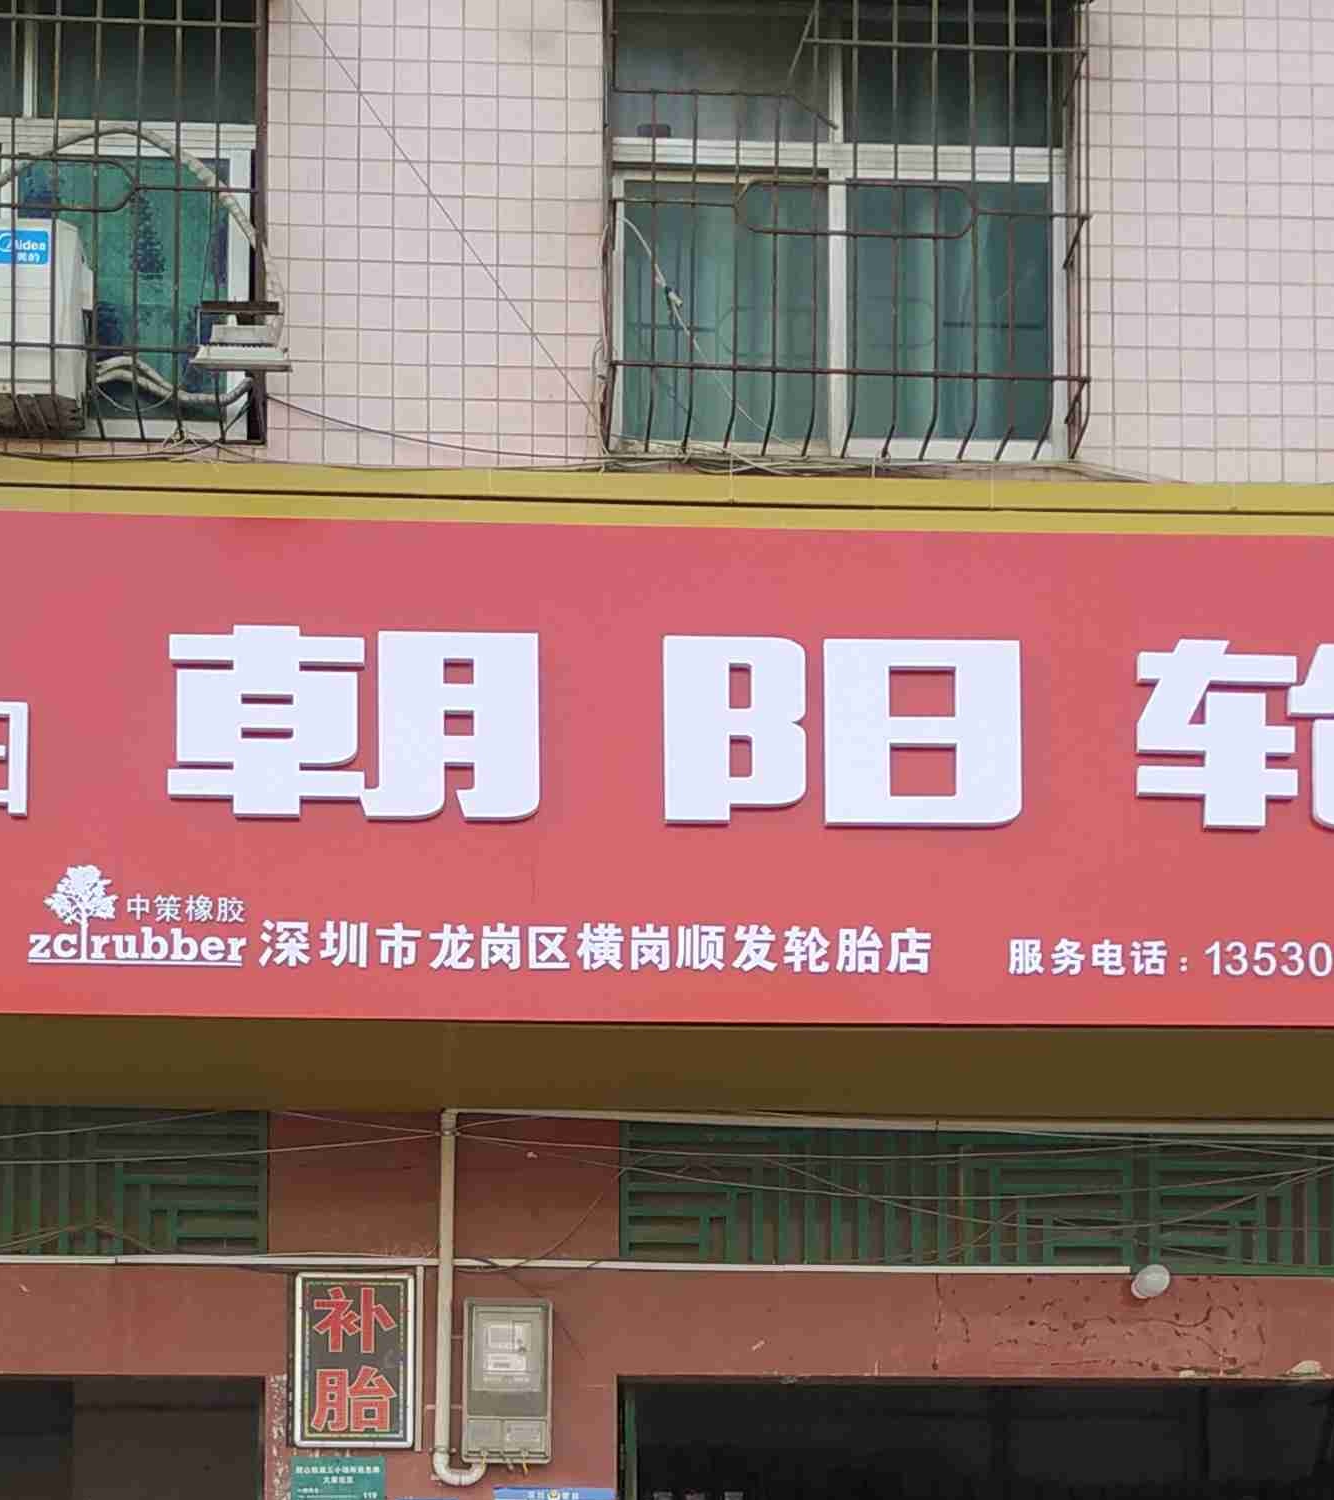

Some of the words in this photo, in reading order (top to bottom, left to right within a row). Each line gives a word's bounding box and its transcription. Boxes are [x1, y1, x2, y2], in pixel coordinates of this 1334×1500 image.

[126, 893, 245, 923] 中策橡胶
[258, 919, 932, 975] 深圳市龙岗区横岗顺发轮胎店
[312, 1285, 397, 1432] 补胎
